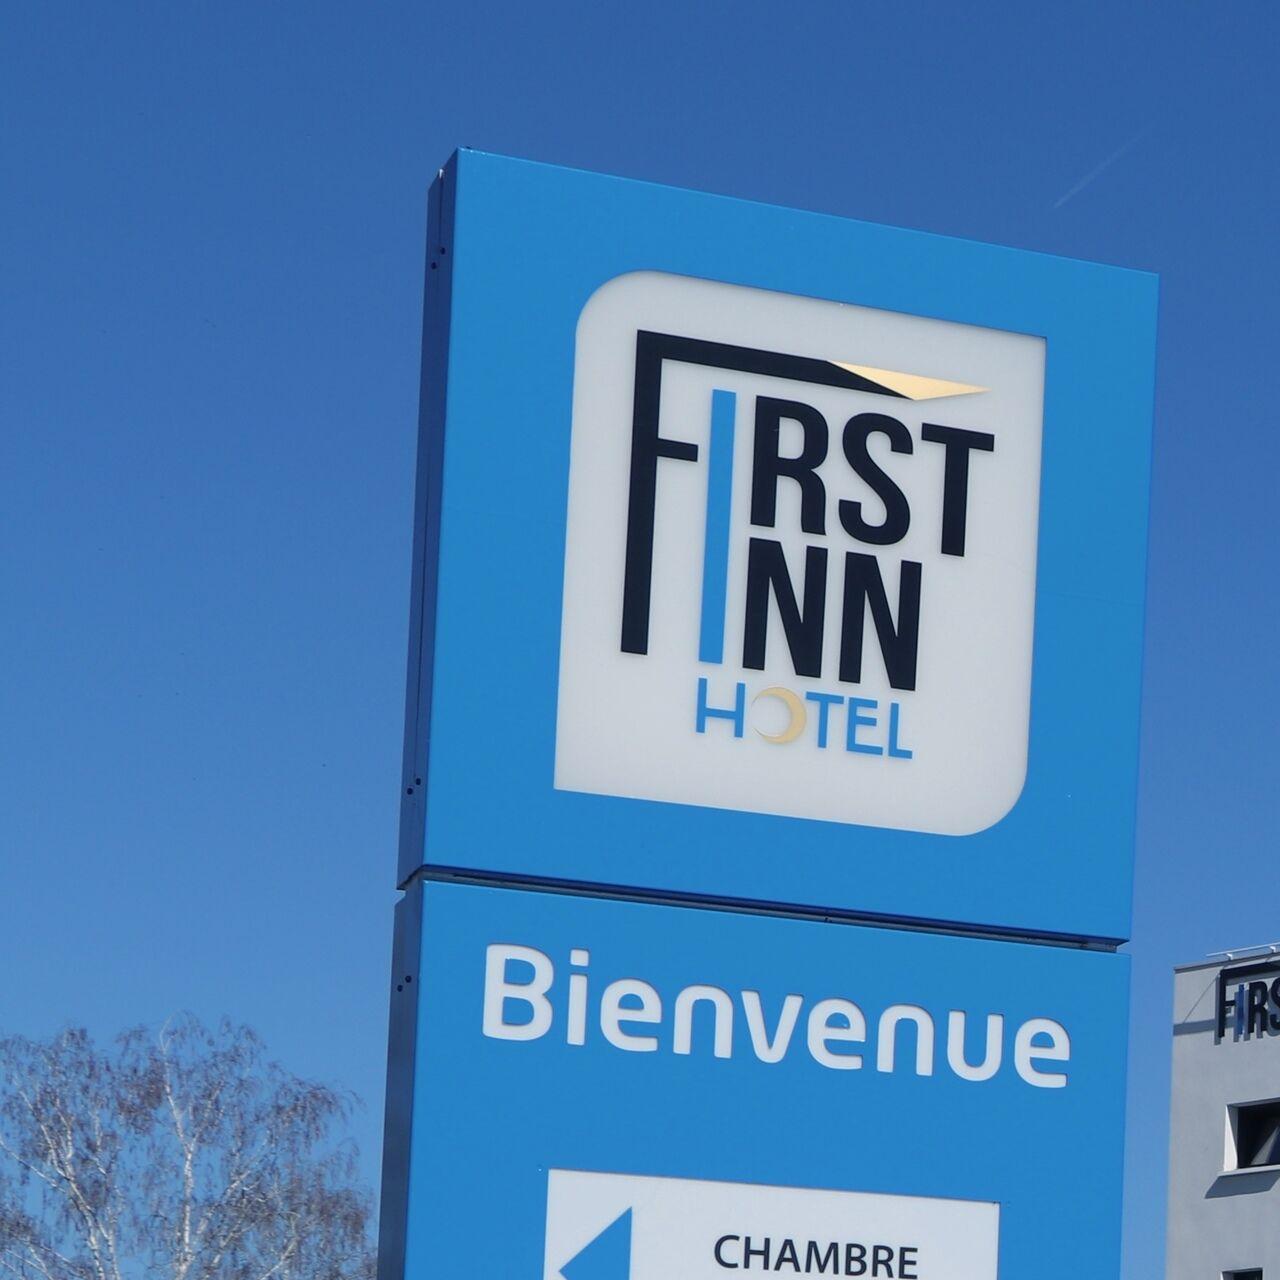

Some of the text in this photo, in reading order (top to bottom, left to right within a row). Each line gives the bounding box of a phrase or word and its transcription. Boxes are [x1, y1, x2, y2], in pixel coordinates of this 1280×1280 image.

[620, 329, 995, 664] FIRST
[695, 677, 913, 760] HOTEL
[482, 943, 1071, 1088] Bienvenue
[714, 1234, 918, 1280] CHAMBRE
